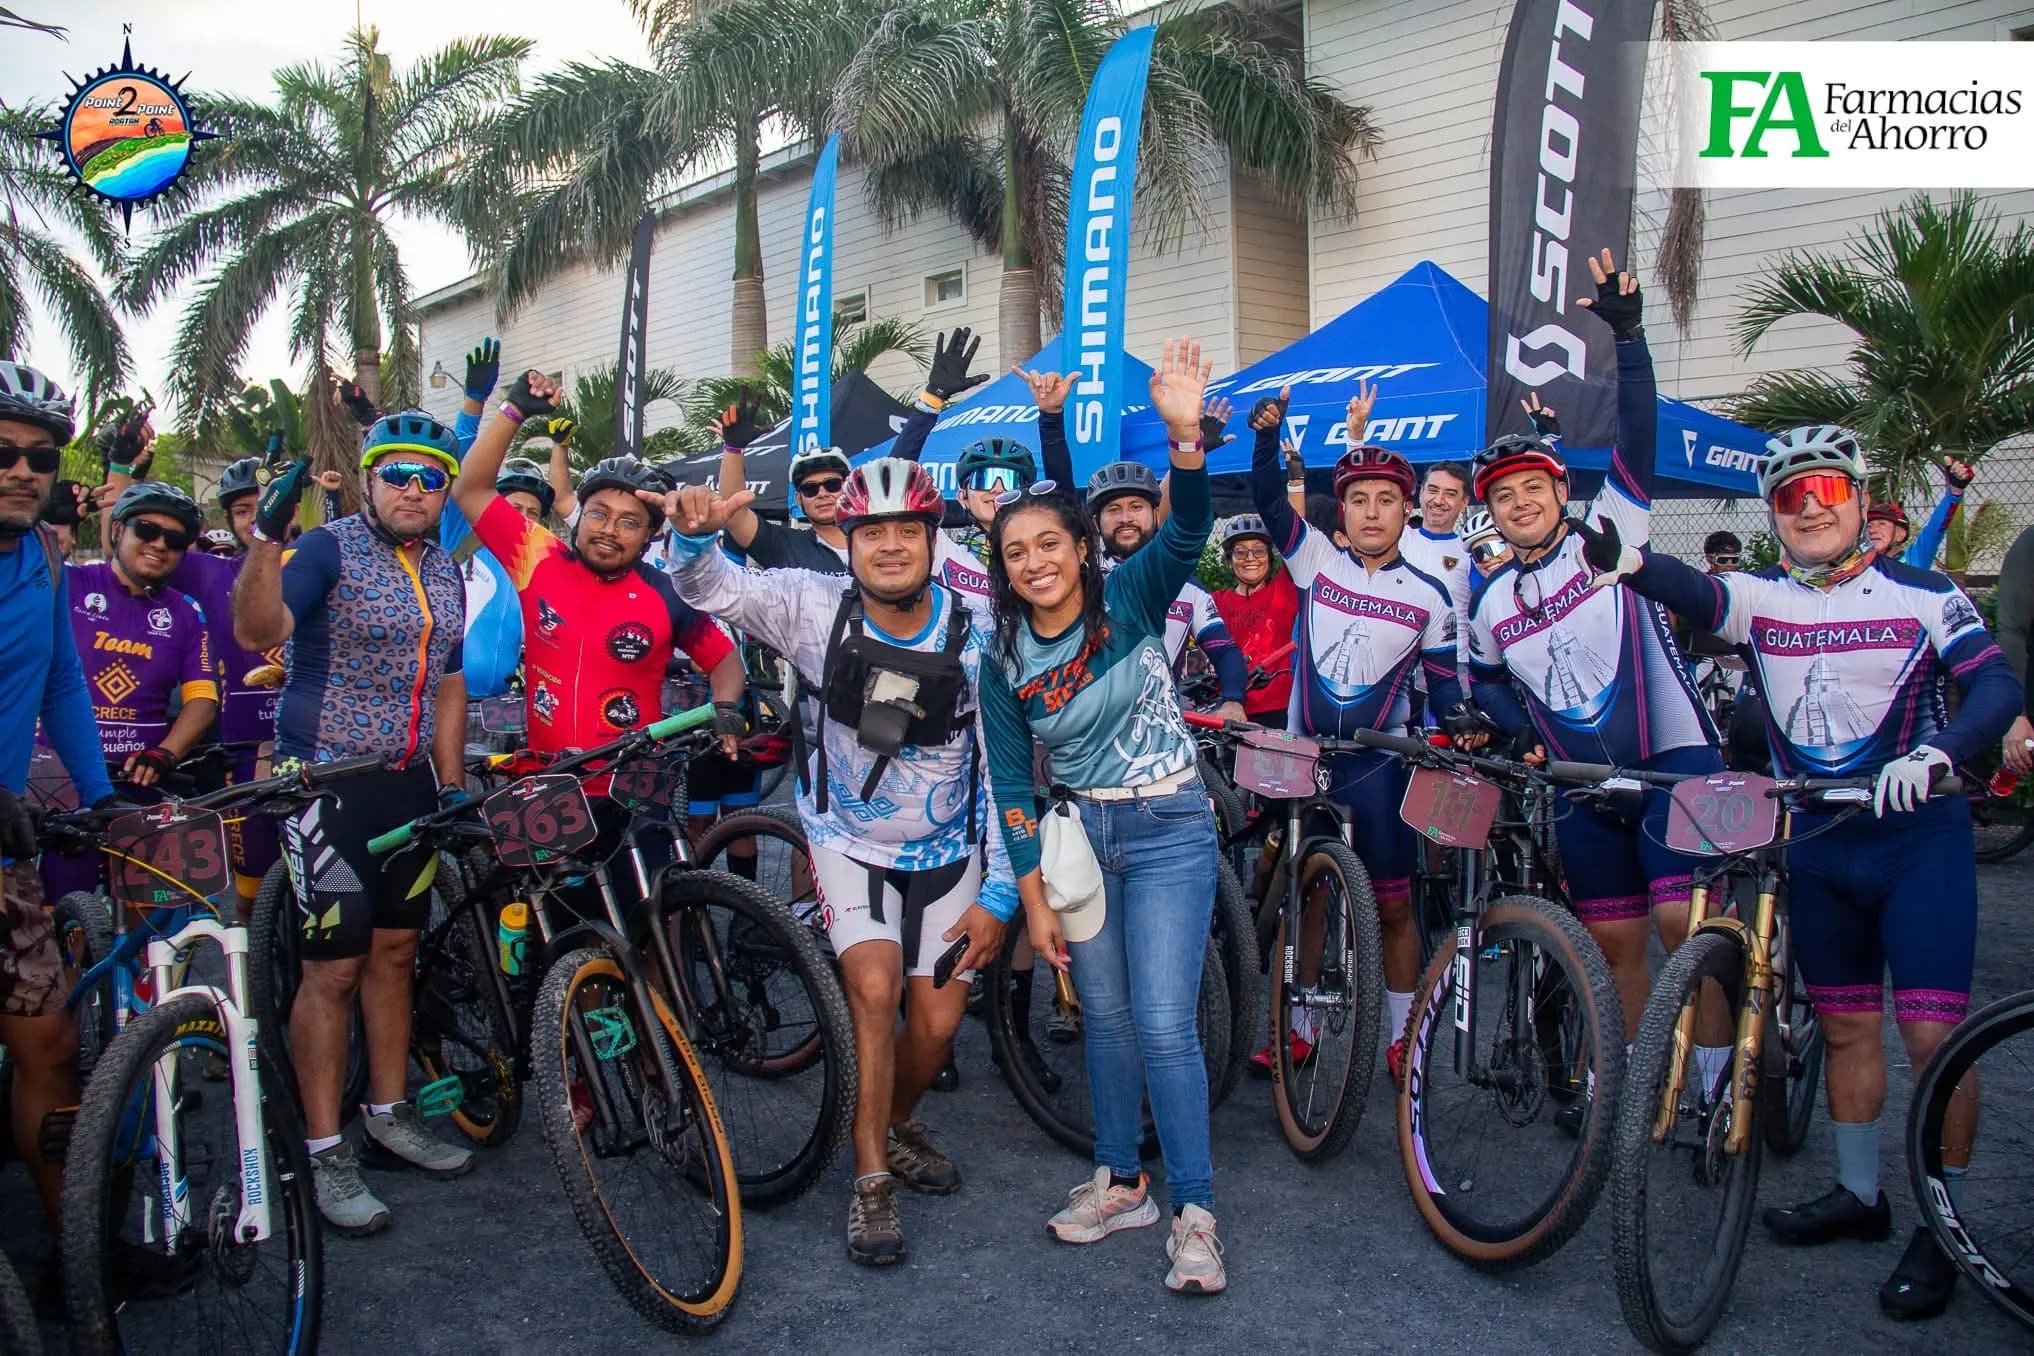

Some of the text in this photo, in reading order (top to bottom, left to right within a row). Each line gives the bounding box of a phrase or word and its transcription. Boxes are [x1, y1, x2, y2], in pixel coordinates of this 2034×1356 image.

[1074, 115, 1122, 444] SHIMANO
[622, 267, 641, 449] SCOTT
[1321, 585, 1417, 624] GUATEMALA
[93, 630, 153, 660] Team
[1766, 626, 1899, 648] GUATEMALA
[491, 791, 588, 854] 263
[1687, 793, 1755, 834] 20
[117, 829, 222, 885] 243
[1283, 945, 1294, 984] ROCKSHOX
[242, 1147, 263, 1206] ROCKSHOX
